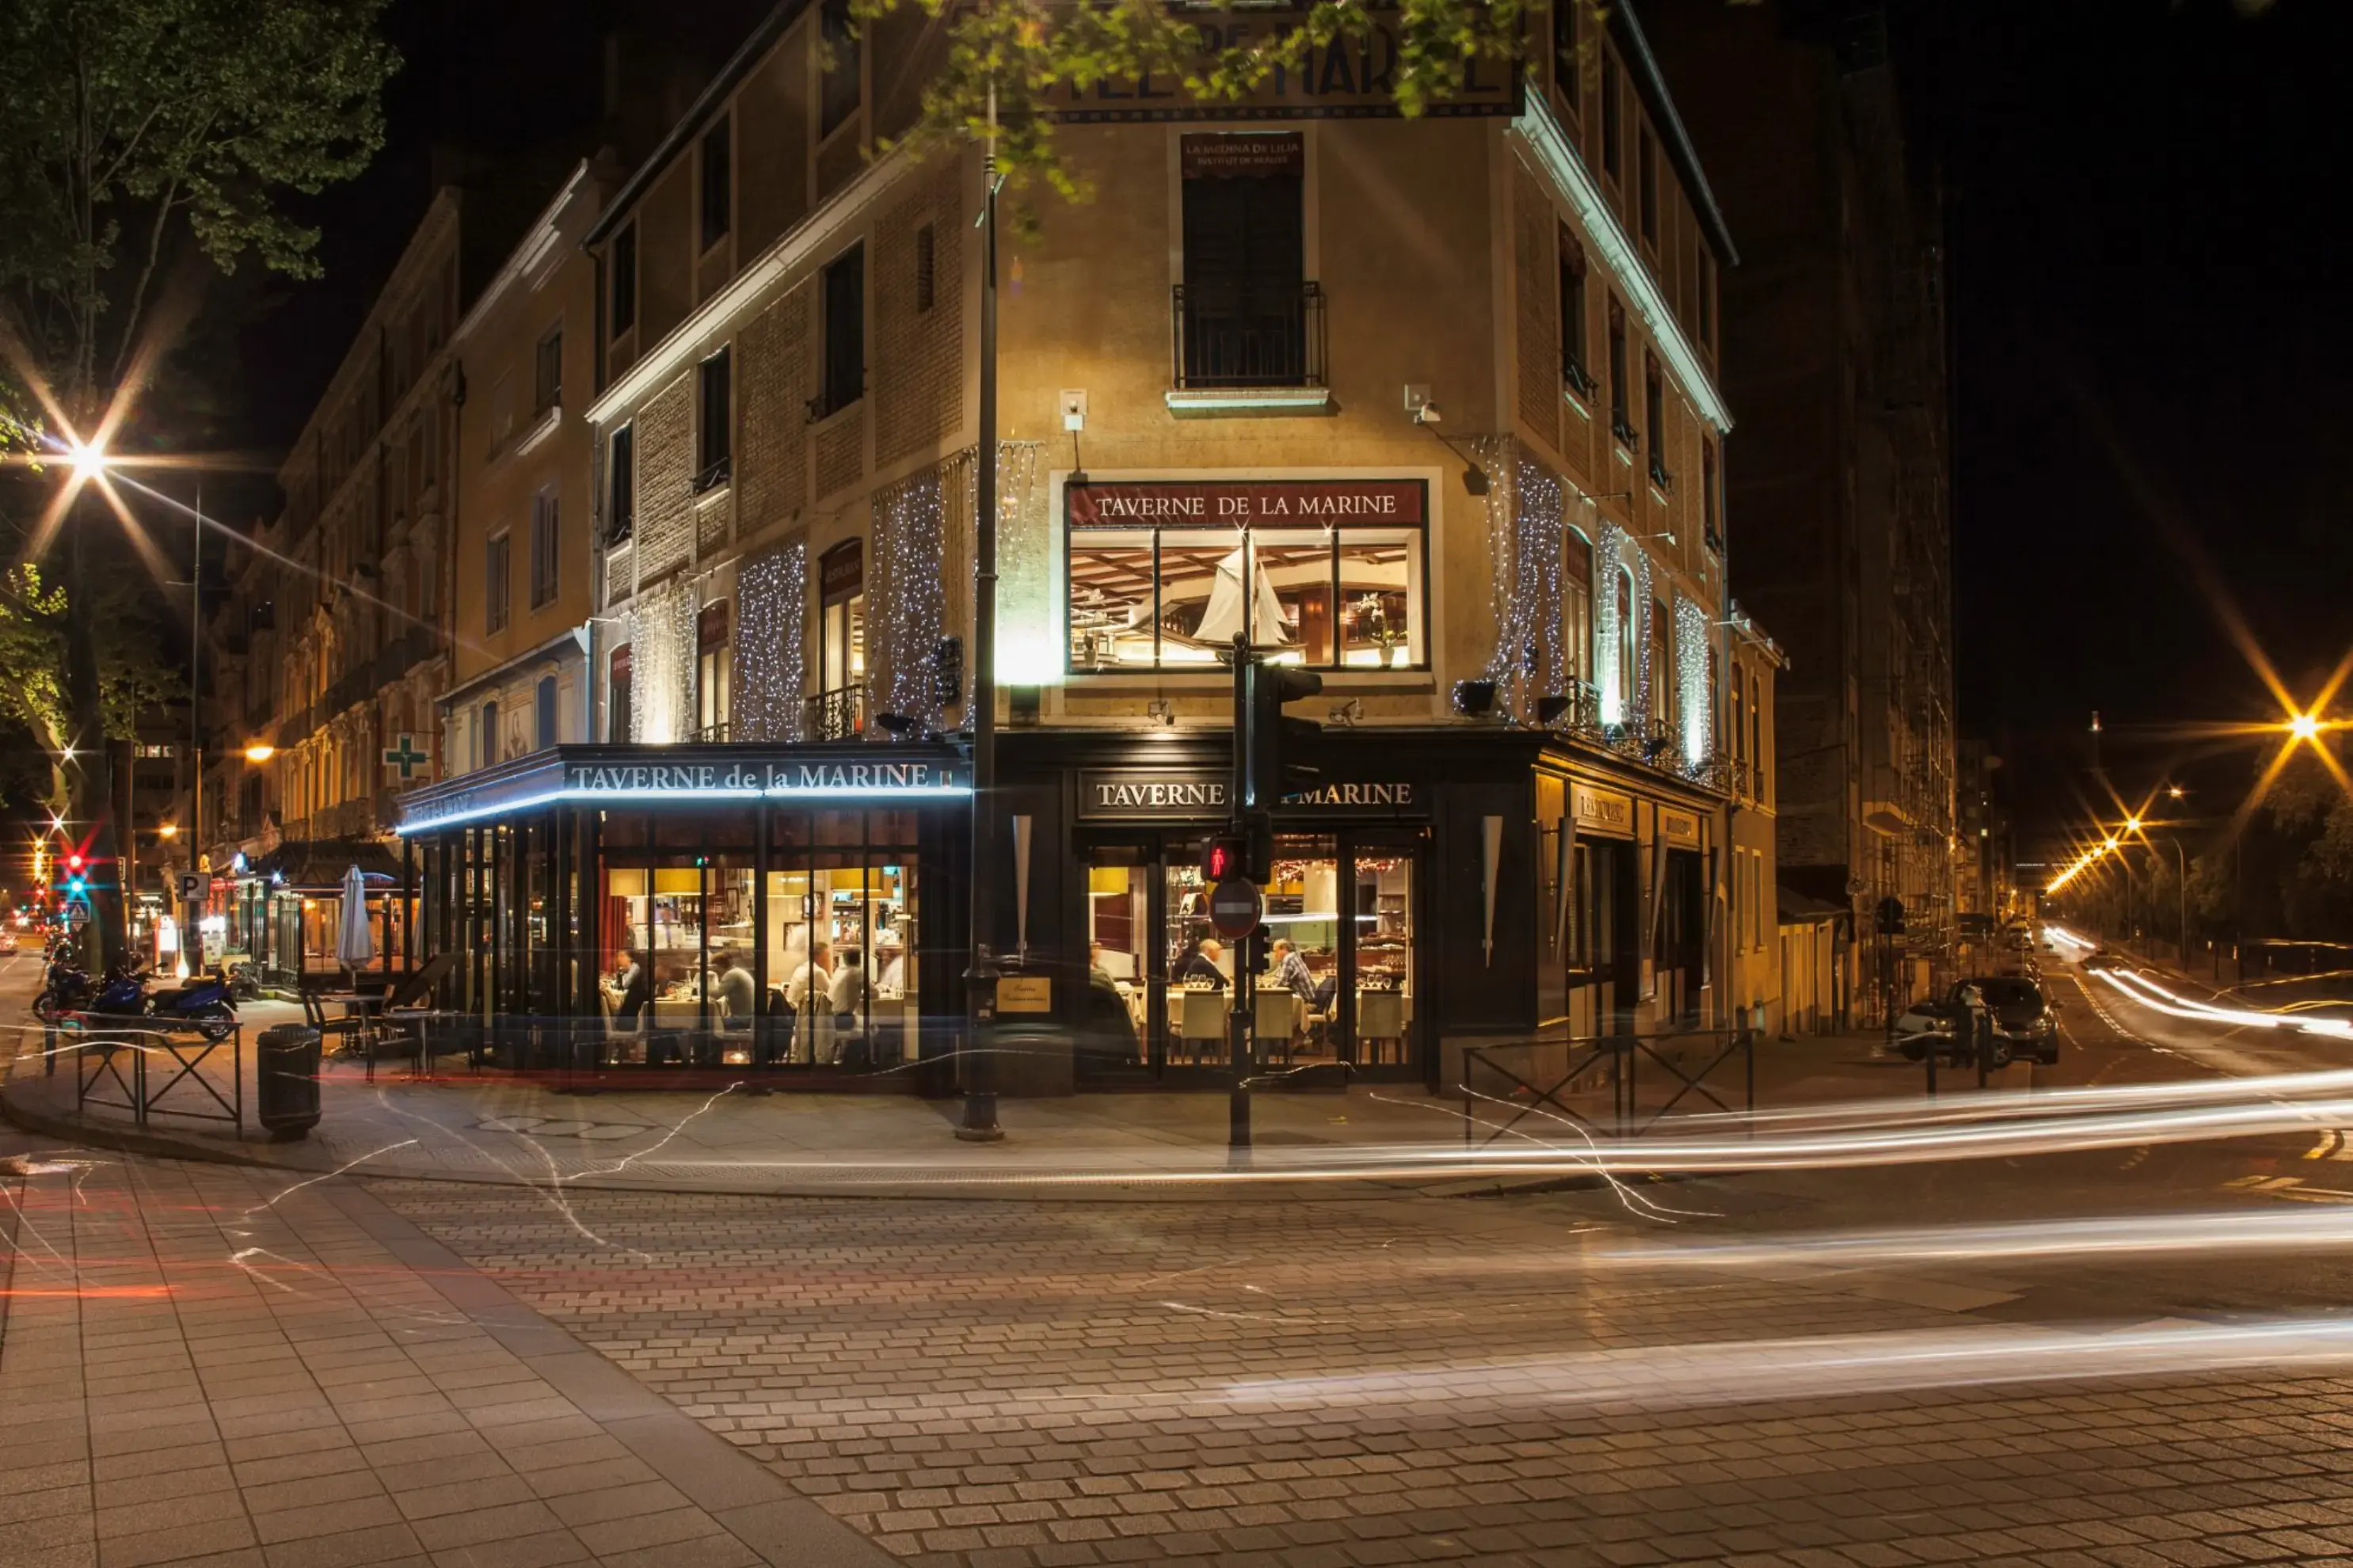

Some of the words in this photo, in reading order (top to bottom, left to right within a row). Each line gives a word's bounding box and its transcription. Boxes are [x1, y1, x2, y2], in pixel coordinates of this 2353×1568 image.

[1186, 144, 1201, 154] LA
[1203, 143, 1250, 154] MEDINA
[1252, 143, 1268, 154] DE
[1239, 156, 1251, 165] DE
[1096, 497, 1205, 517] TAVERNE
[1217, 497, 1250, 516] DE
[1260, 496, 1289, 515] LA
[1298, 495, 1396, 515] MARINE
[571, 765, 717, 791] TAVERNE
[724, 763, 757, 789] de
[766, 764, 790, 790] la
[800, 763, 930, 789] MARINE
[1096, 783, 1224, 805] TAVERNE
[1296, 783, 1412, 805] MARINE
[183, 876, 199, 896] P
